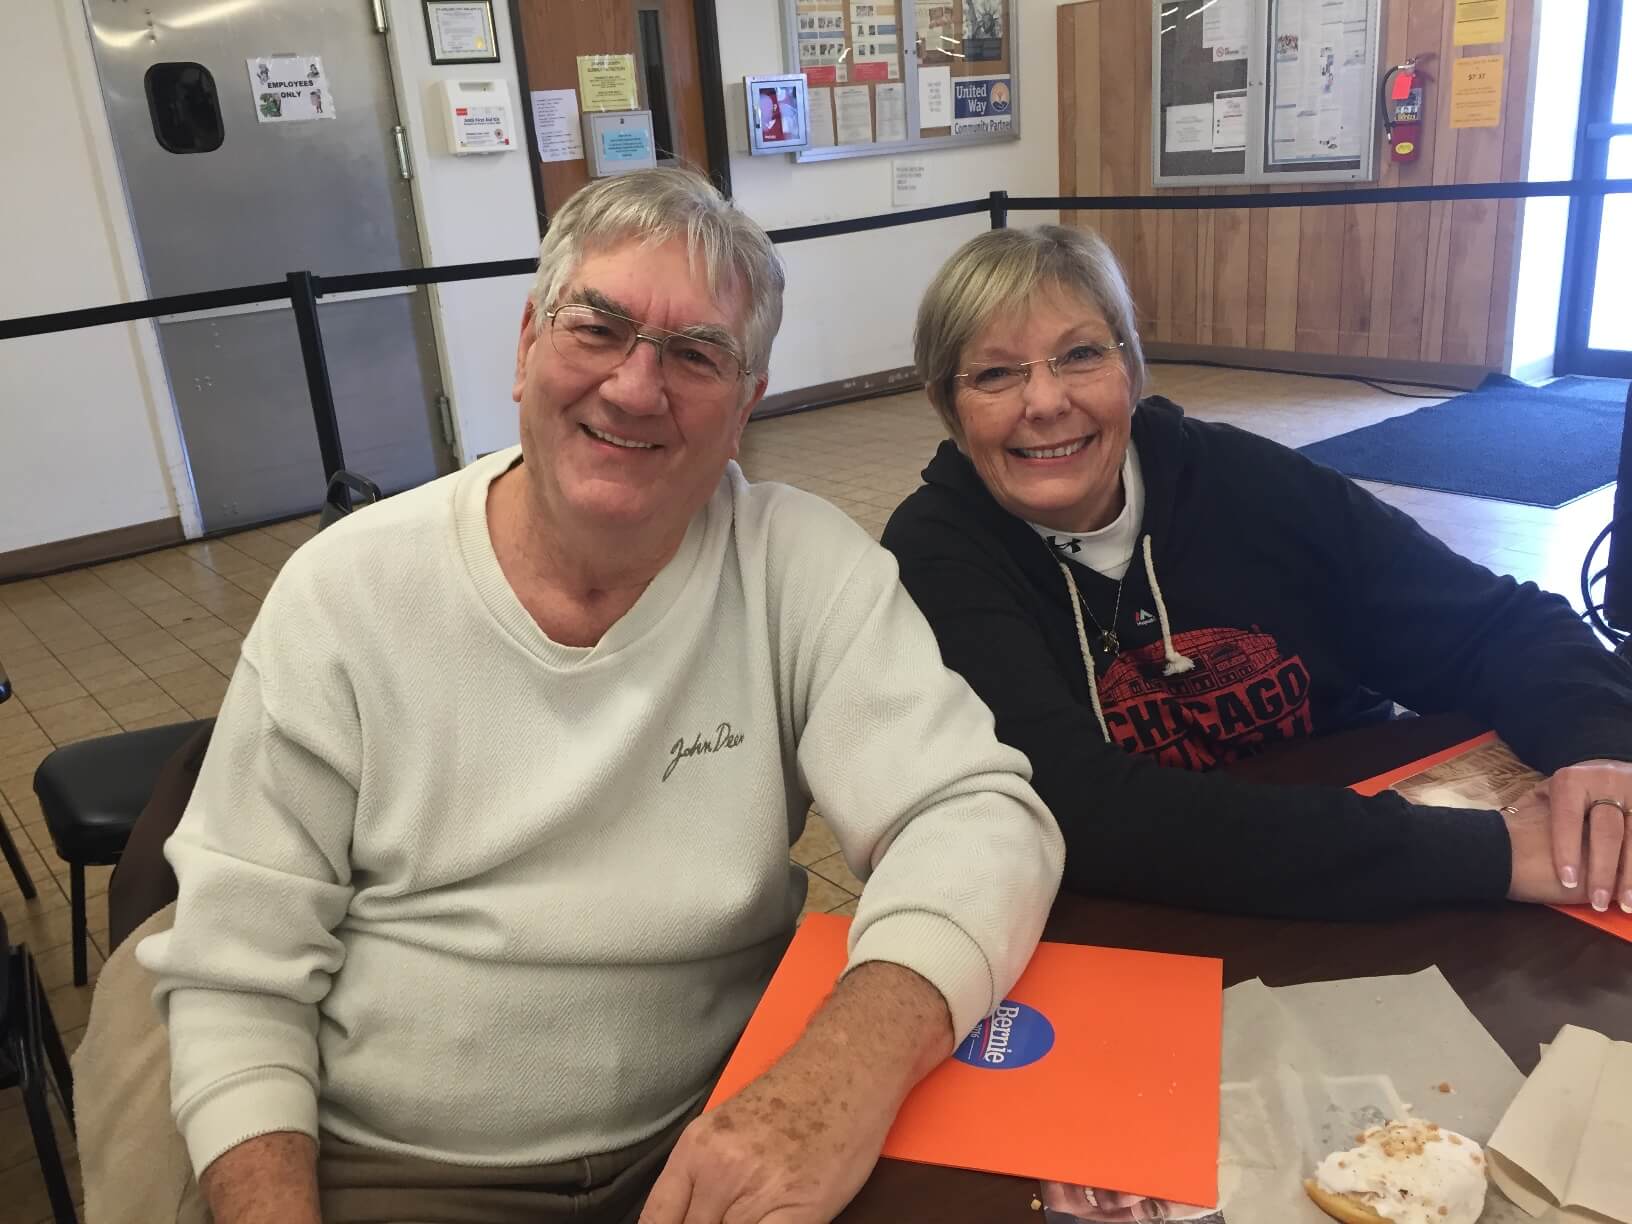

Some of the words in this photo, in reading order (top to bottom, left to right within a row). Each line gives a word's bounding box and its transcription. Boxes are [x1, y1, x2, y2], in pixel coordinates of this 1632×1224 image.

[267, 80, 314, 89] EMPLOYEES
[955, 83, 987, 99] United
[280, 91, 302, 99] ONLY
[967, 99, 987, 115] Way
[954, 120, 990, 135] Community
[1103, 662, 1307, 754] CHICAGO
[661, 732, 713, 783] John
[984, 1006, 1020, 1064] Bernie
